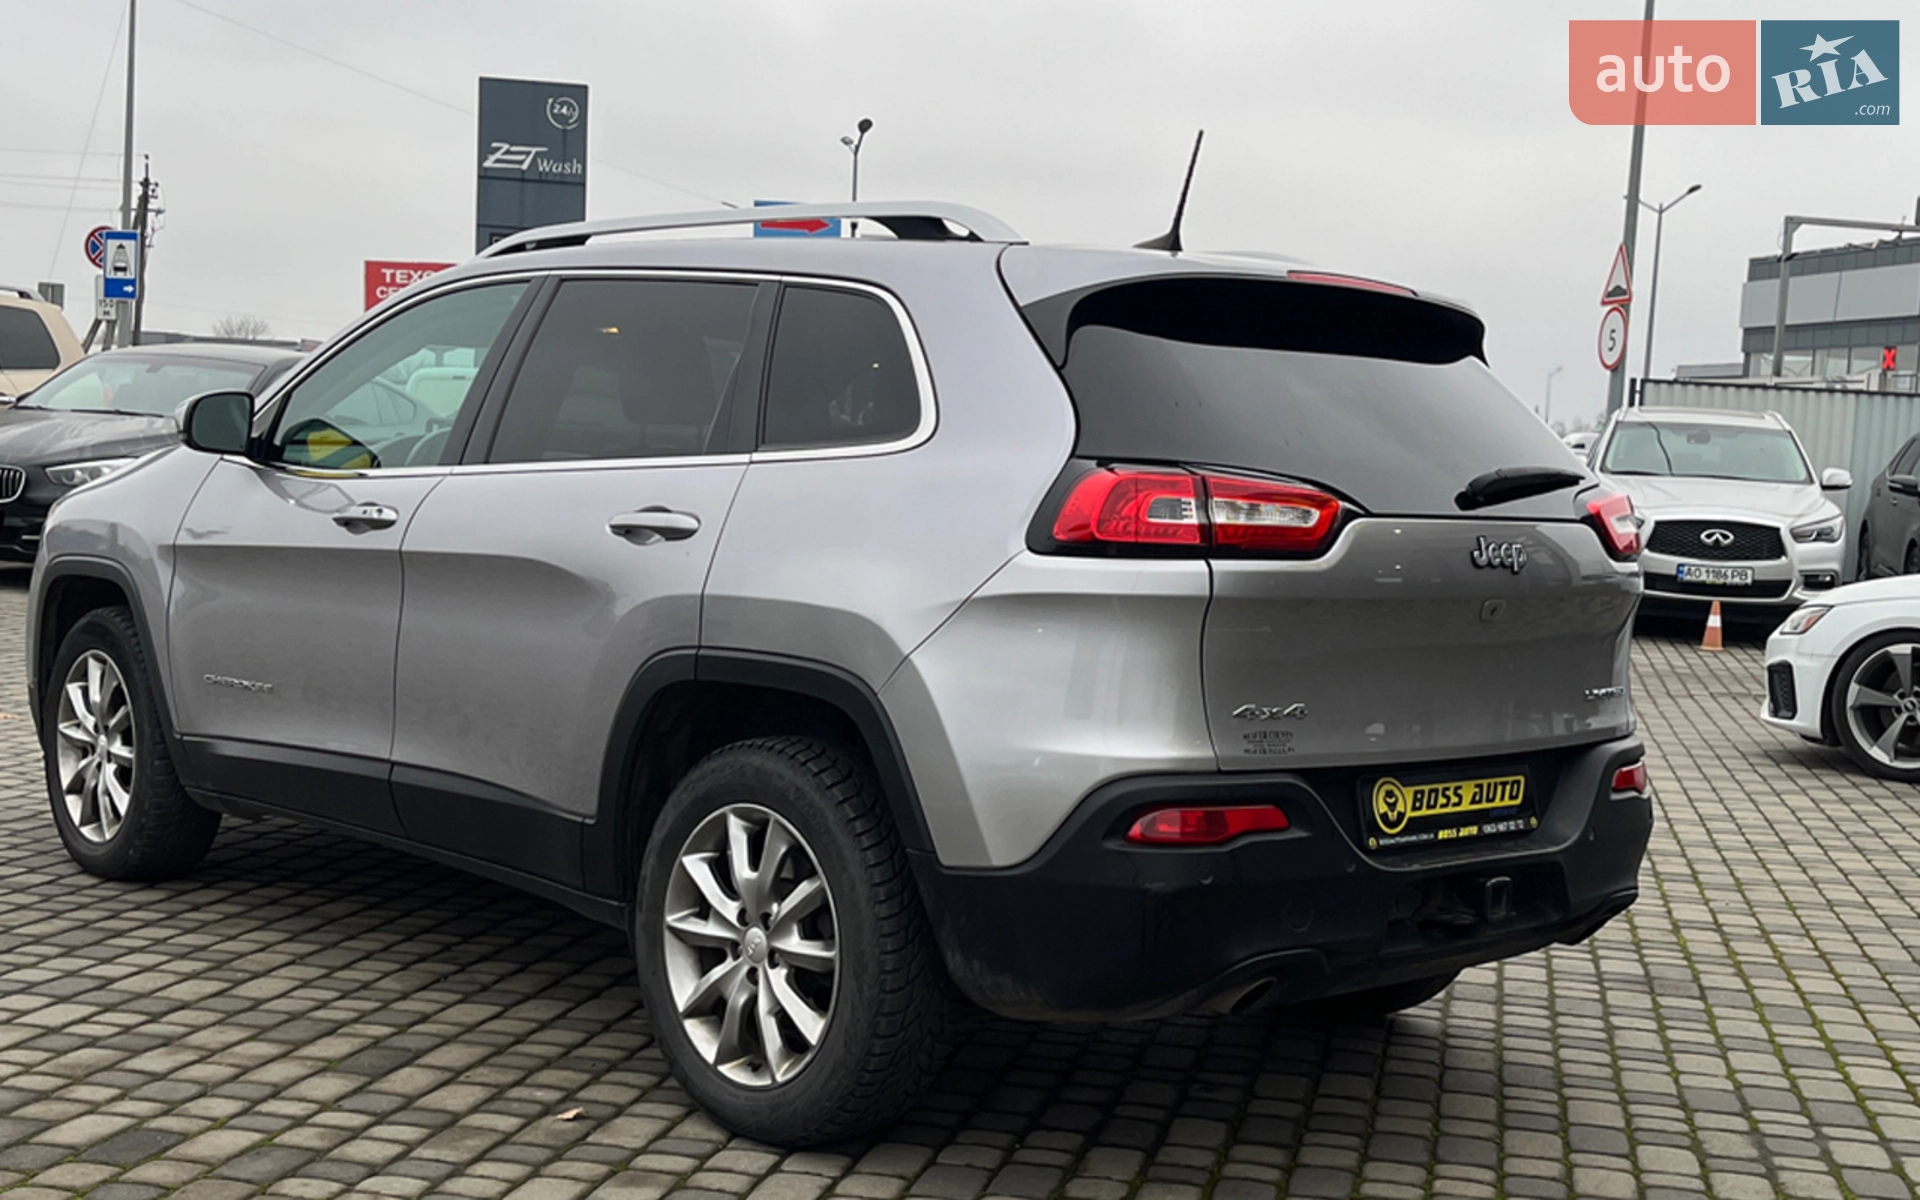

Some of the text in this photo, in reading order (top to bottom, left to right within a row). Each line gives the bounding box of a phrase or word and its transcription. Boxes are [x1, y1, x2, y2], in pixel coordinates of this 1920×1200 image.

[482, 142, 582, 174] ZET Wash
[1608, 328, 1616, 352] 5
[1470, 535, 1528, 575] Jeep
[1231, 702, 1309, 721] 4x4
[1411, 785, 1463, 813] BOSS
[1468, 779, 1521, 806] AUTO
